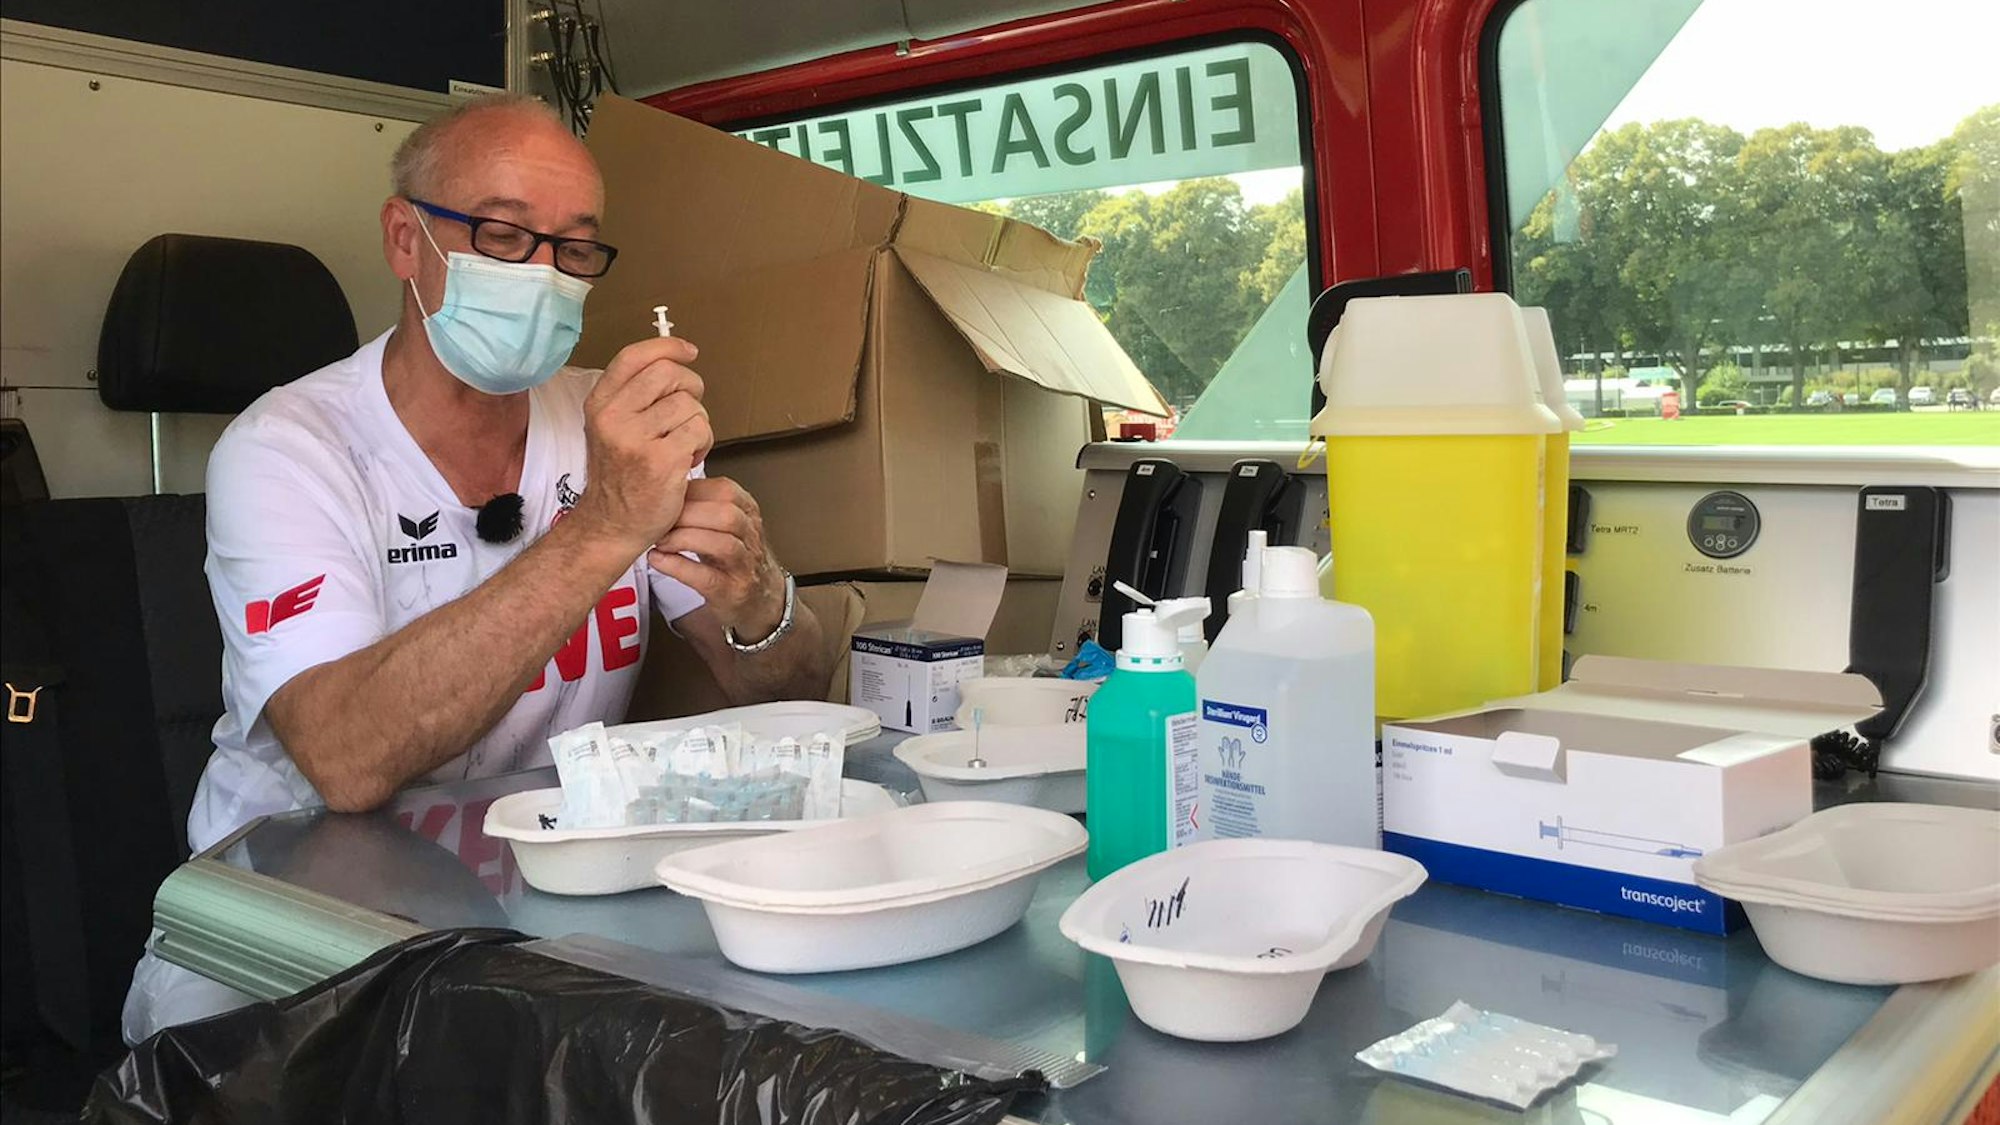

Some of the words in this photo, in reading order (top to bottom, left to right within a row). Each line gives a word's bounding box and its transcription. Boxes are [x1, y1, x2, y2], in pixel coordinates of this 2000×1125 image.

[1872, 498, 1898, 507] Tetra
[387, 543, 457, 564] erima
[1685, 563, 1714, 573] Zusatz
[1716, 565, 1751, 575] Batterie
